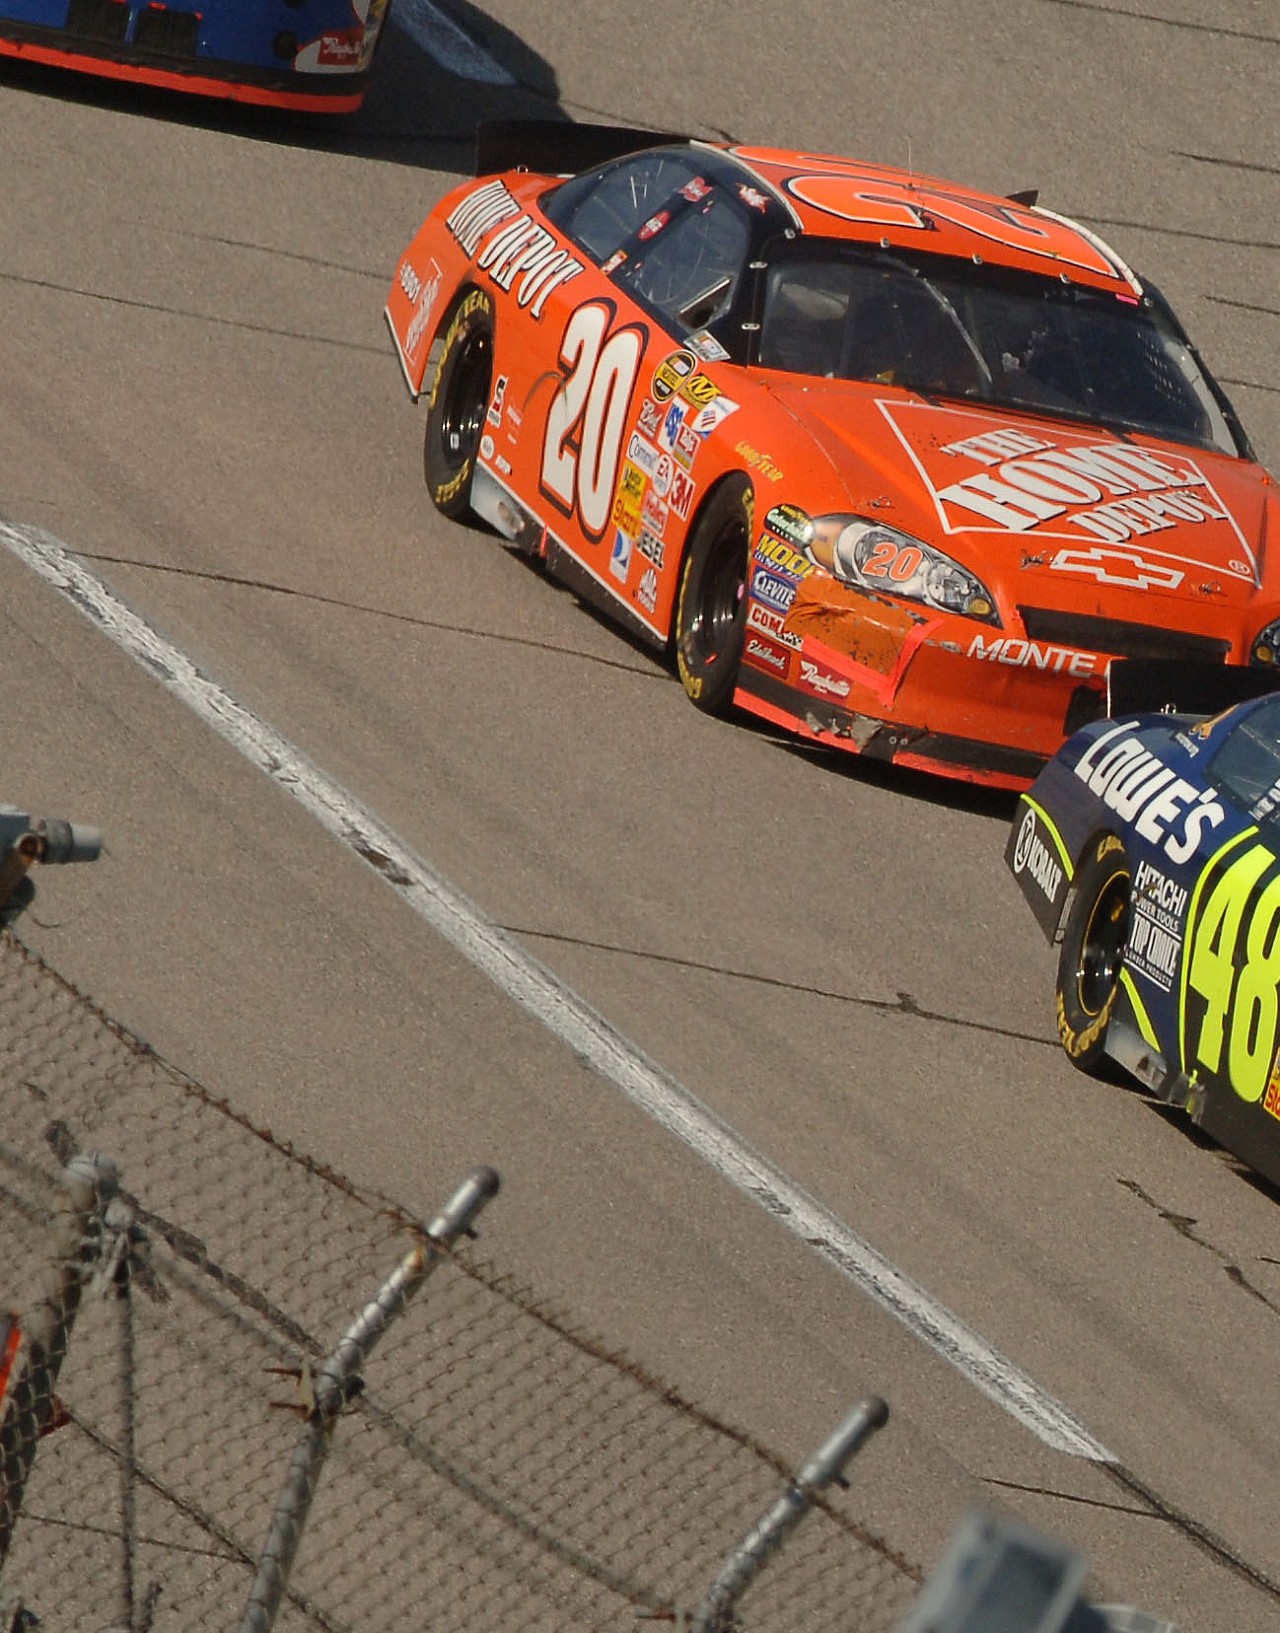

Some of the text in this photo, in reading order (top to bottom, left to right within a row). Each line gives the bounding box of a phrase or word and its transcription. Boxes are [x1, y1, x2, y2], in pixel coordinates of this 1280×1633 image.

[478, 214, 585, 318] DEPOT
[540, 297, 649, 544] 20
[939, 427, 1058, 467] THE
[671, 472, 694, 520] 3M
[936, 444, 1208, 532] HOME
[1067, 488, 1229, 543] DEPOT
[754, 570, 796, 606] CLEVITE
[861, 542, 924, 582] 20
[966, 634, 1097, 679] MONTE
[1074, 721, 1226, 866] LOWE'S
[1027, 834, 1063, 903] KOBALT
[1134, 860, 1188, 918] HITACHI
[1130, 890, 1180, 933] POWER TOOLS
[1129, 912, 1151, 955] TOP
[1146, 925, 1182, 978] CHOICE
